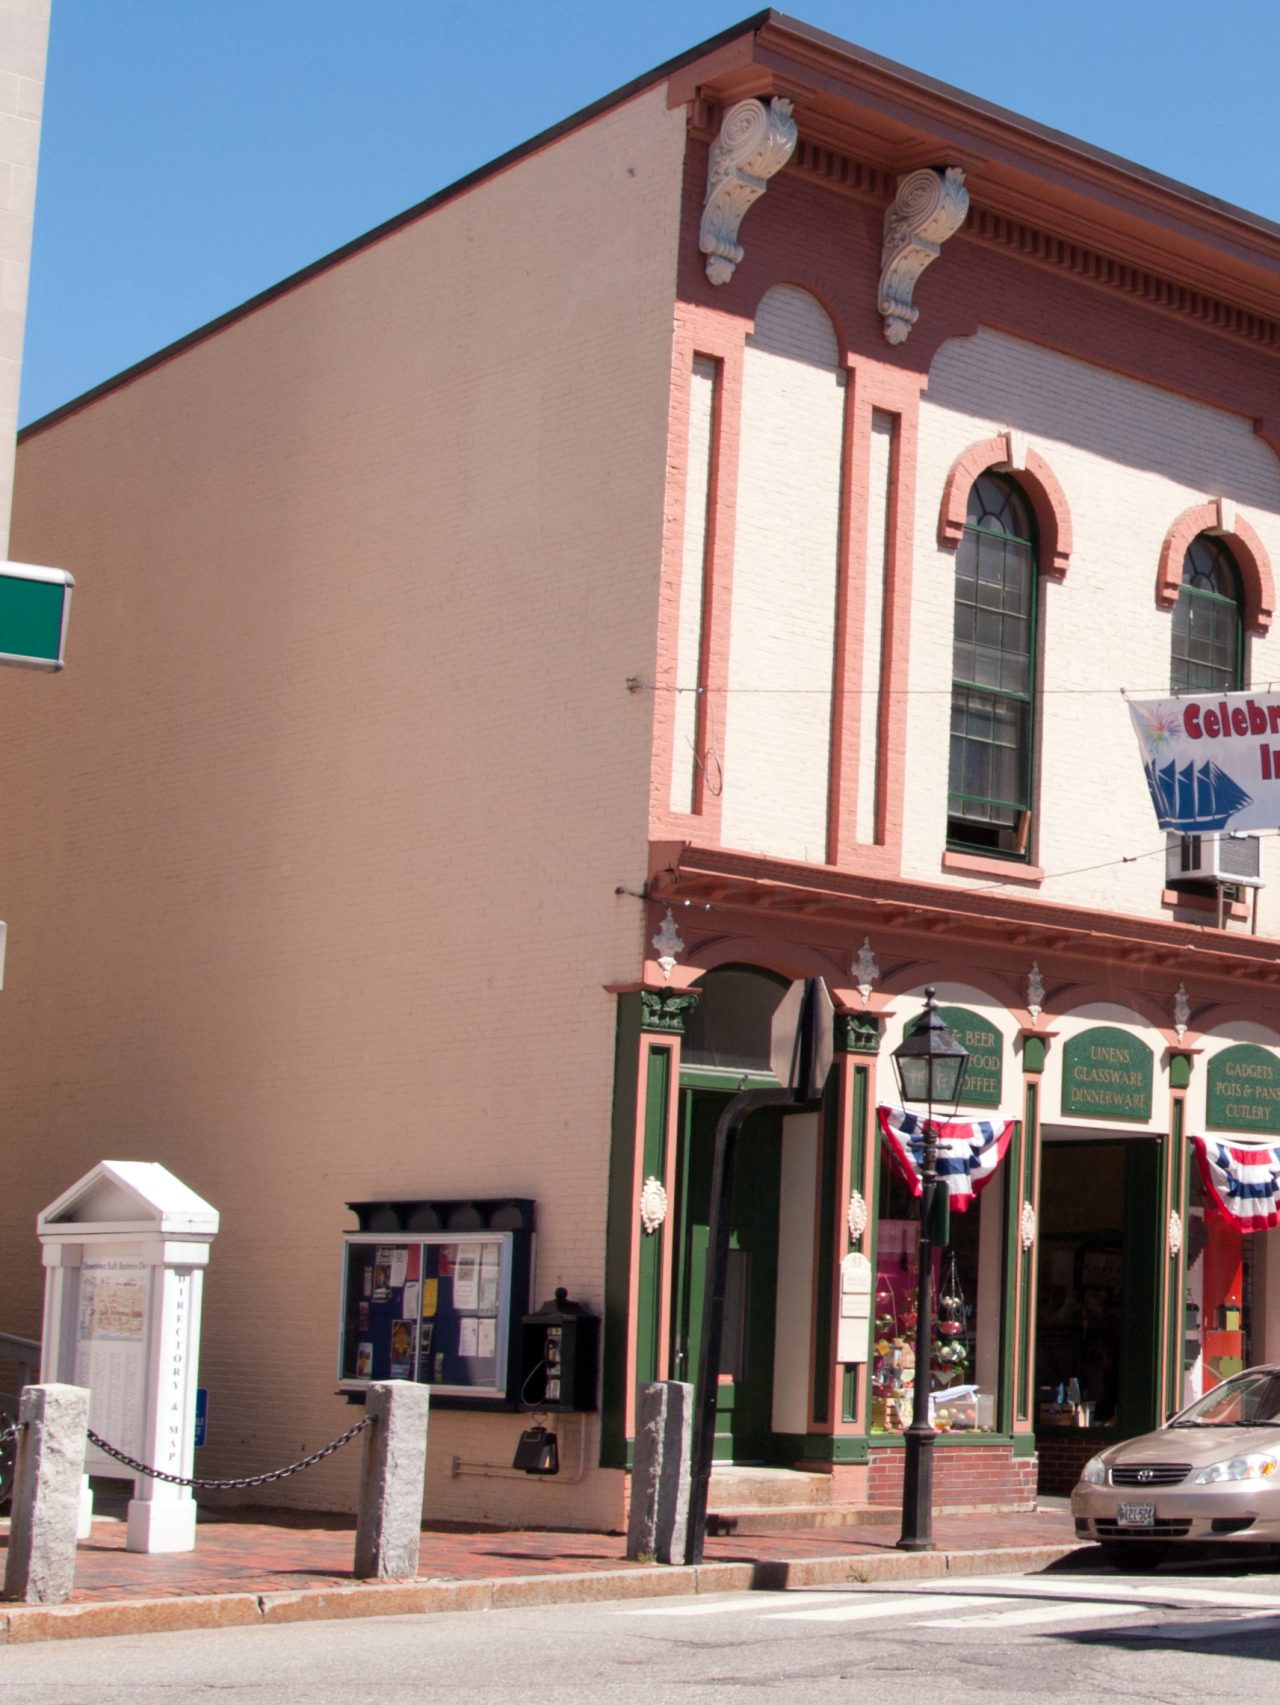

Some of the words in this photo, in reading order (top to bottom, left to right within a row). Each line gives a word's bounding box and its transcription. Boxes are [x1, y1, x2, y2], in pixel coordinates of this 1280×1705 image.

[965, 1030, 996, 1047] BEER
[968, 1054, 1000, 1070] FOOD
[1090, 1045, 1130, 1063] LINENS
[1074, 1066, 1144, 1086] GLASSWARE
[1225, 1062, 1273, 1080] GADGETS
[951, 1073, 997, 1093] COFFEE
[1216, 1081, 1241, 1097] POTS
[1243, 1085, 1253, 1097] &
[1071, 1087, 1146, 1108] DINNERWARE
[1225, 1103, 1272, 1120] CUTLERY
[172, 1275, 187, 1391] DIRECTORY
[168, 1425, 179, 1462] MAP
